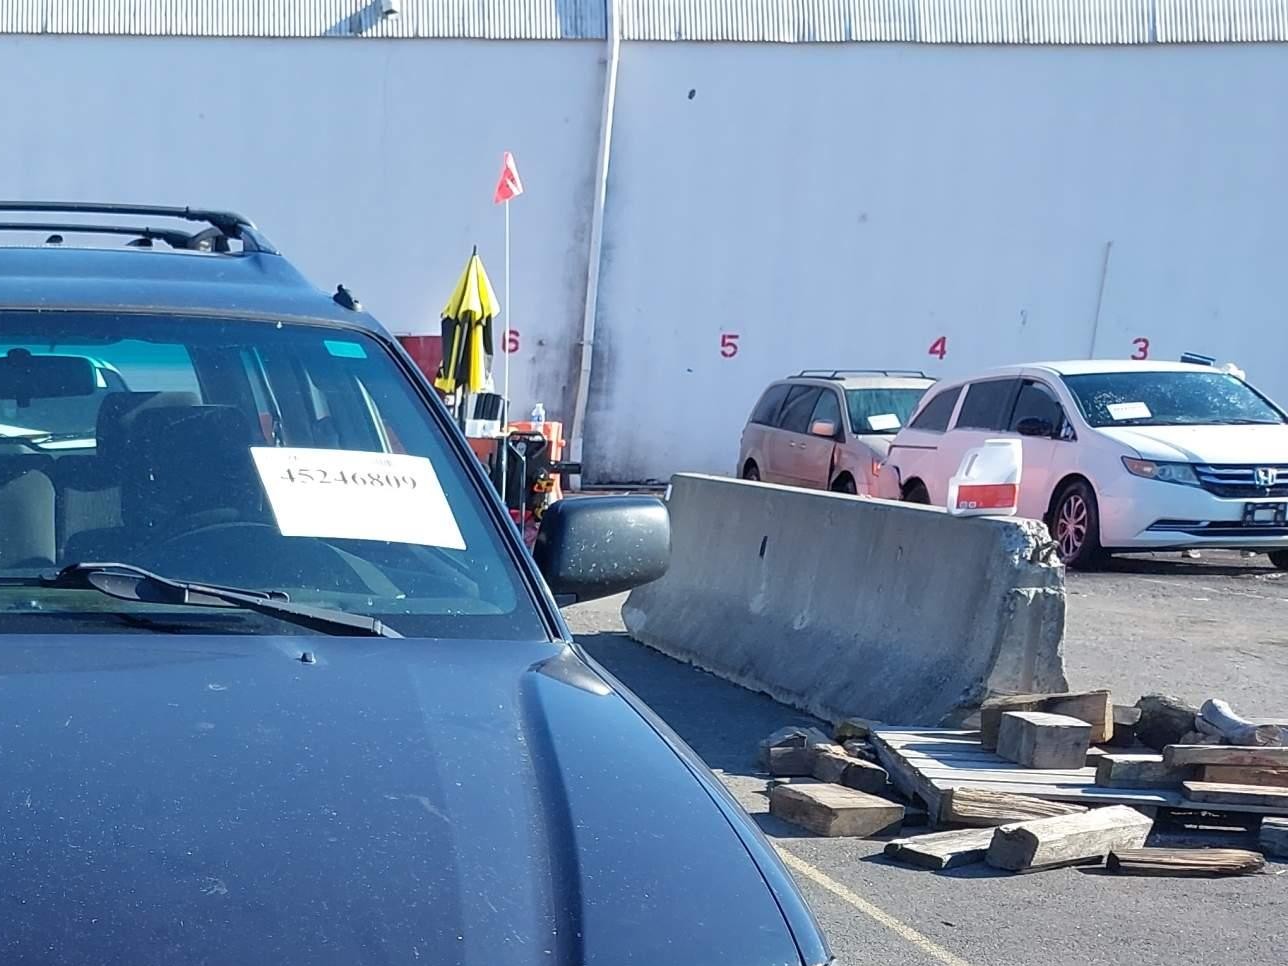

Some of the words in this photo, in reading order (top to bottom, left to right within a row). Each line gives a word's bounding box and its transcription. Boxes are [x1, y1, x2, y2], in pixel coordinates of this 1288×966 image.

[501, 328, 520, 354] 6
[720, 333, 740, 358] 5
[928, 335, 947, 360] 4
[1130, 337, 1150, 361] 3
[280, 468, 418, 490] 45246809
